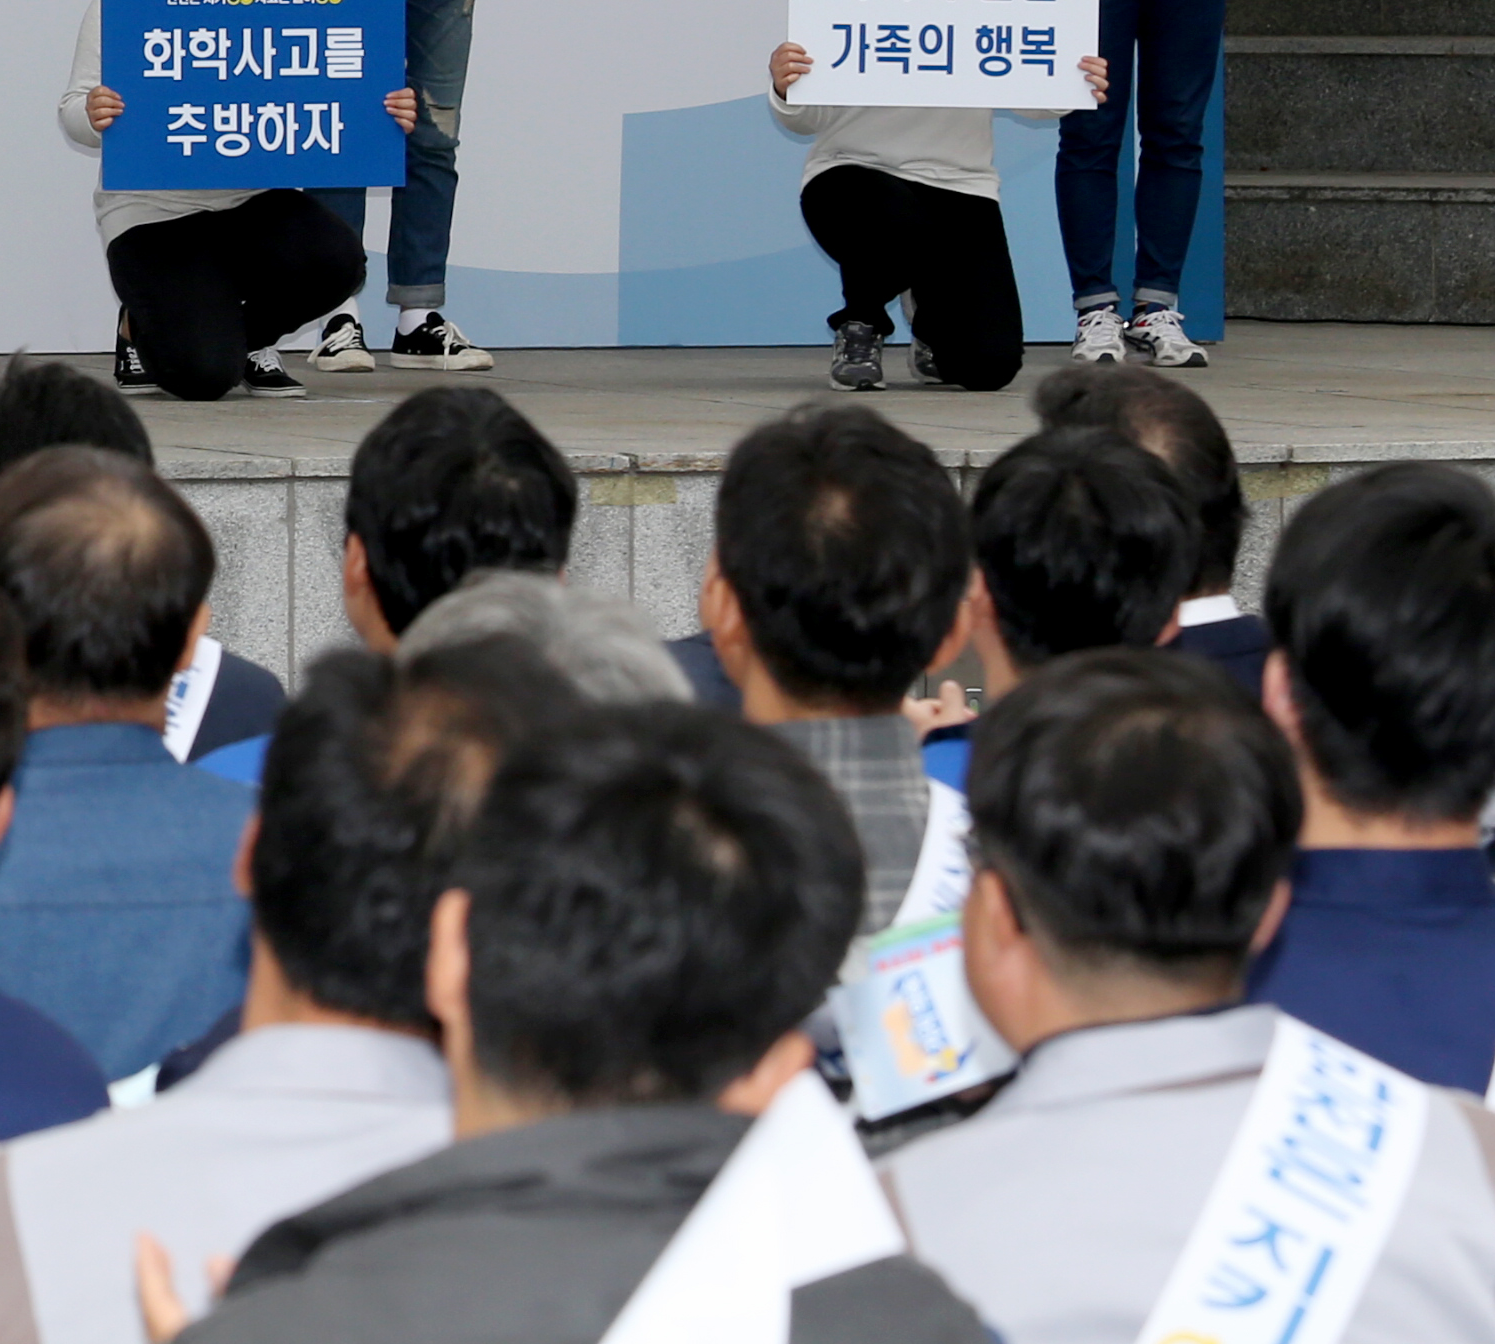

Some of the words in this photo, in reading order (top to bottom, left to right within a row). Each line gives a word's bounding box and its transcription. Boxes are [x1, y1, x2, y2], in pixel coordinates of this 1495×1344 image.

[144, 28, 365, 80] 화학사고를
[831, 23, 954, 75] 가족의
[975, 25, 1057, 77] 행복
[167, 102, 345, 156] 추방하자
